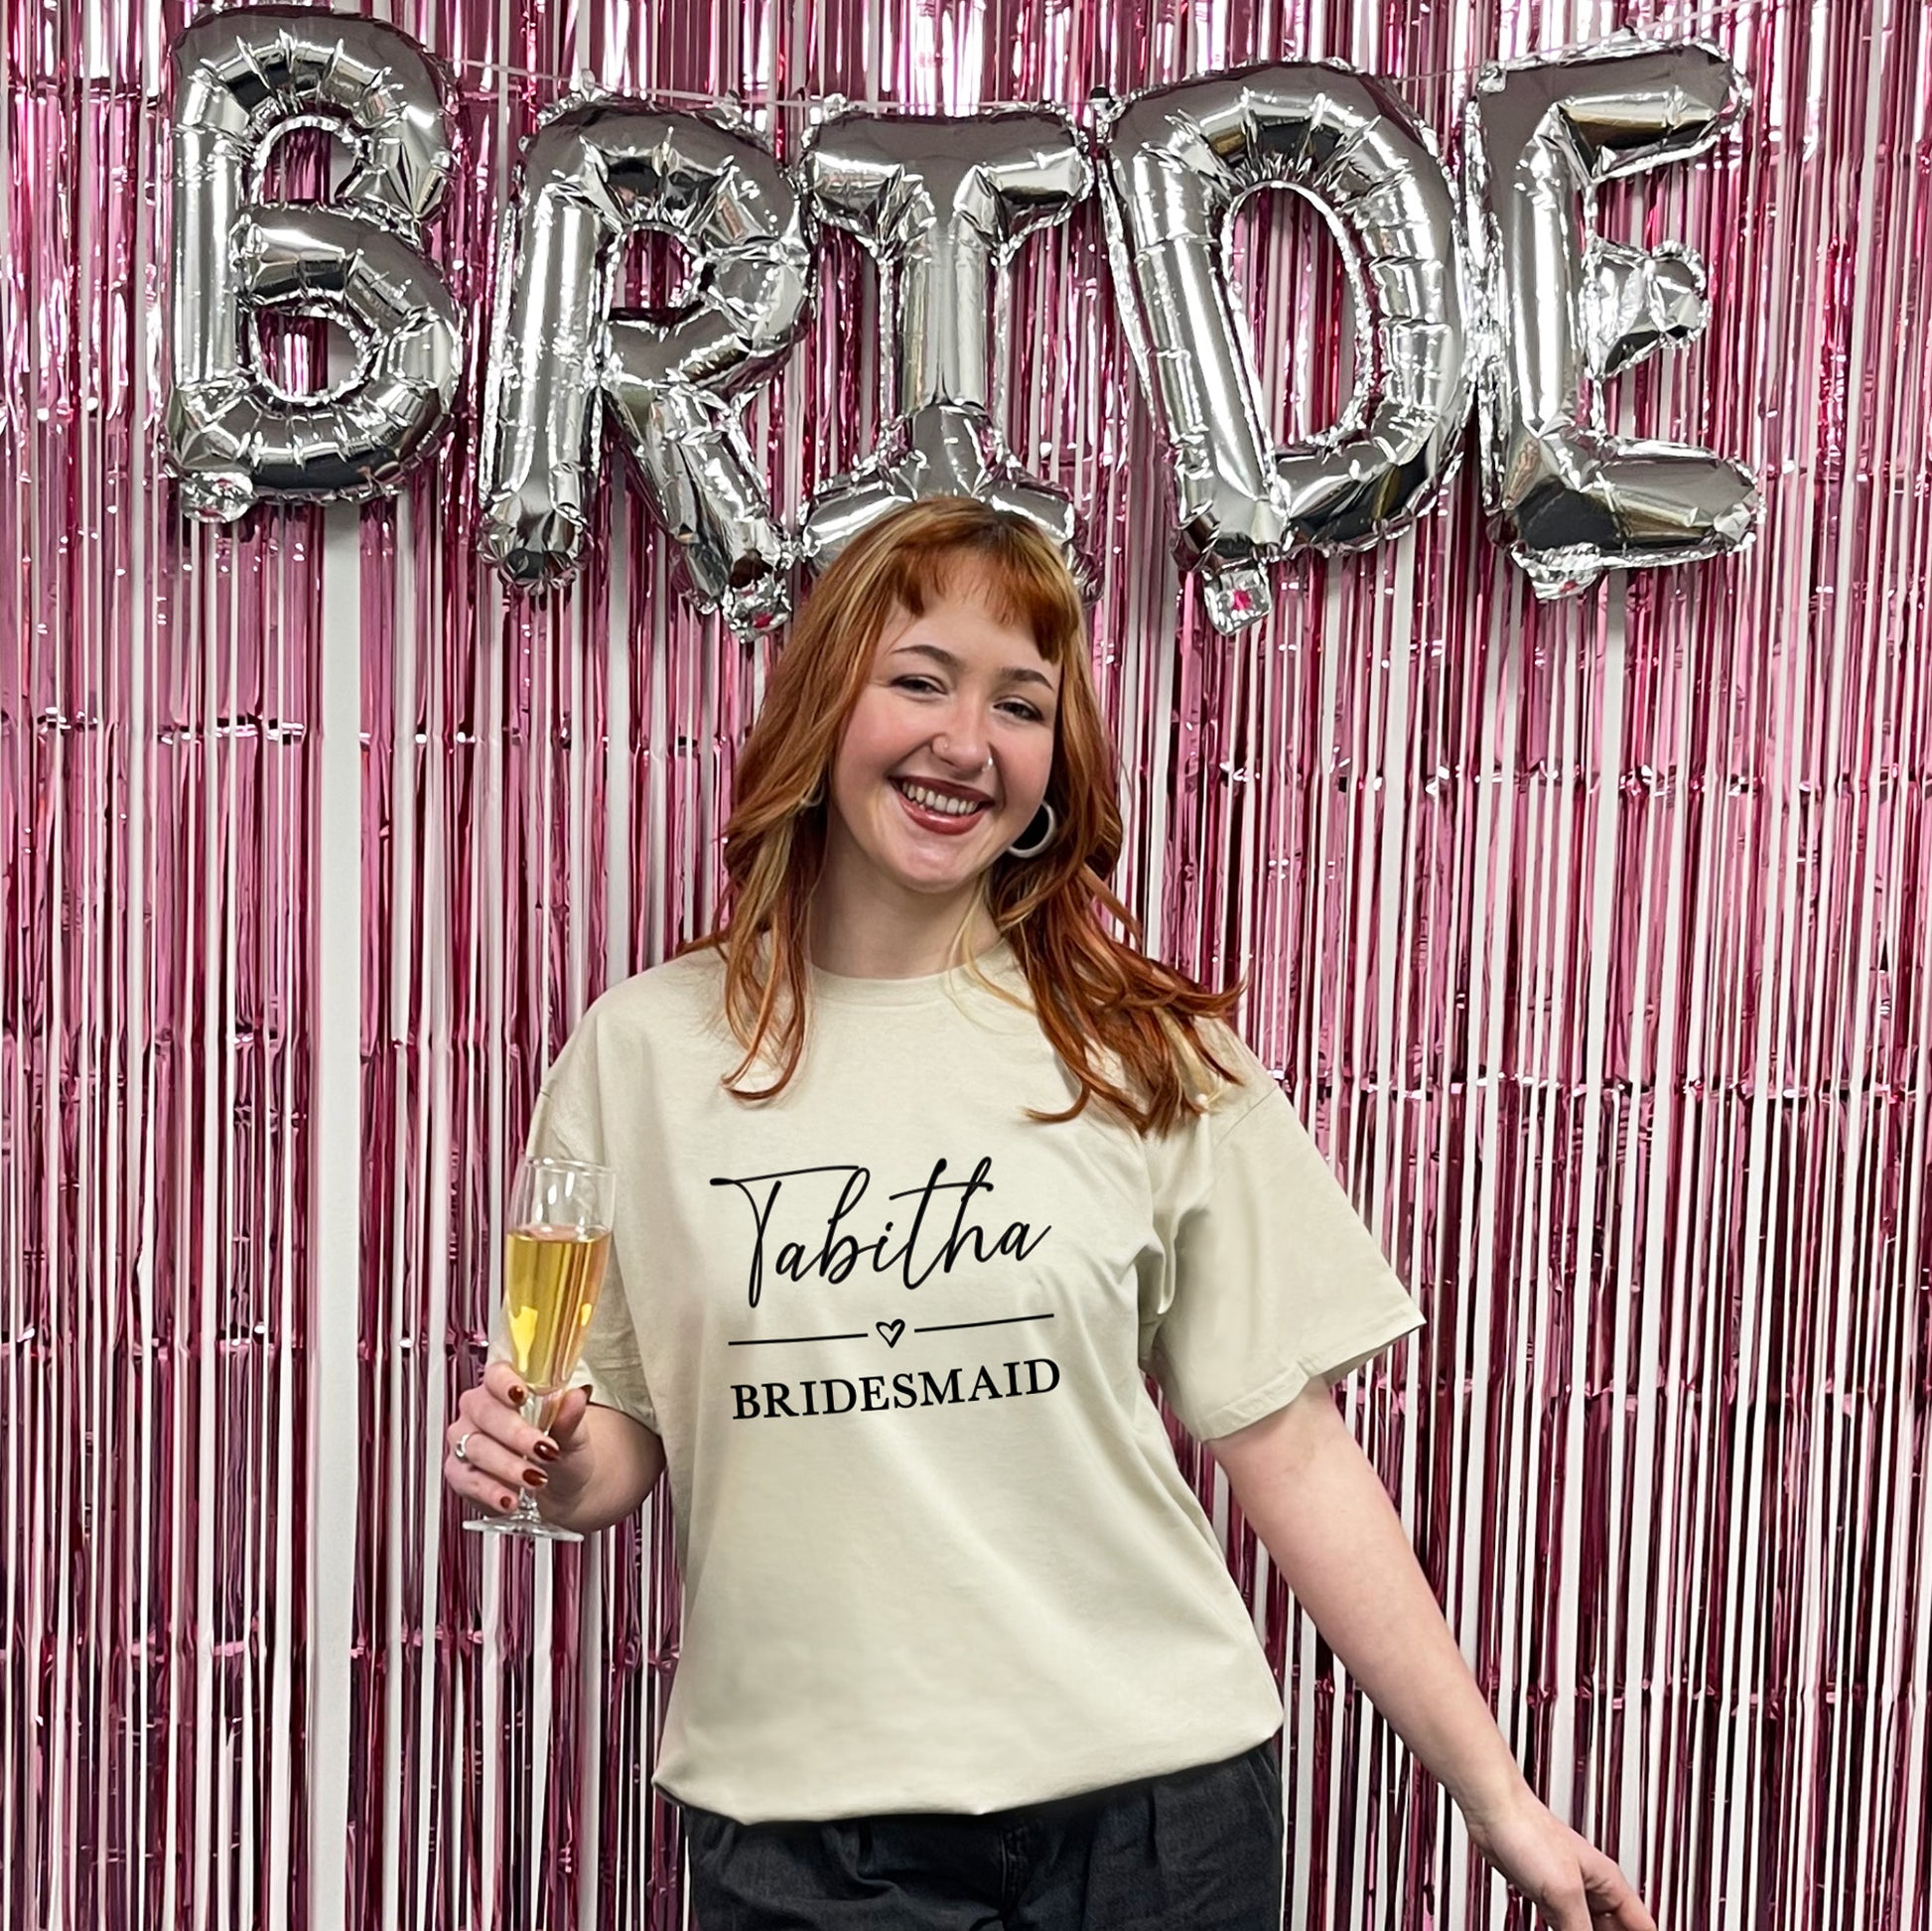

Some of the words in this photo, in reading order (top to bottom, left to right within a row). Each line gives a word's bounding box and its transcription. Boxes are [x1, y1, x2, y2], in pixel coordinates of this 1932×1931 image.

[162, 4, 1763, 631] BRIDE
[709, 1156, 1052, 1309] Tabitha
[730, 1357, 1061, 1421] BRIDESMAID
